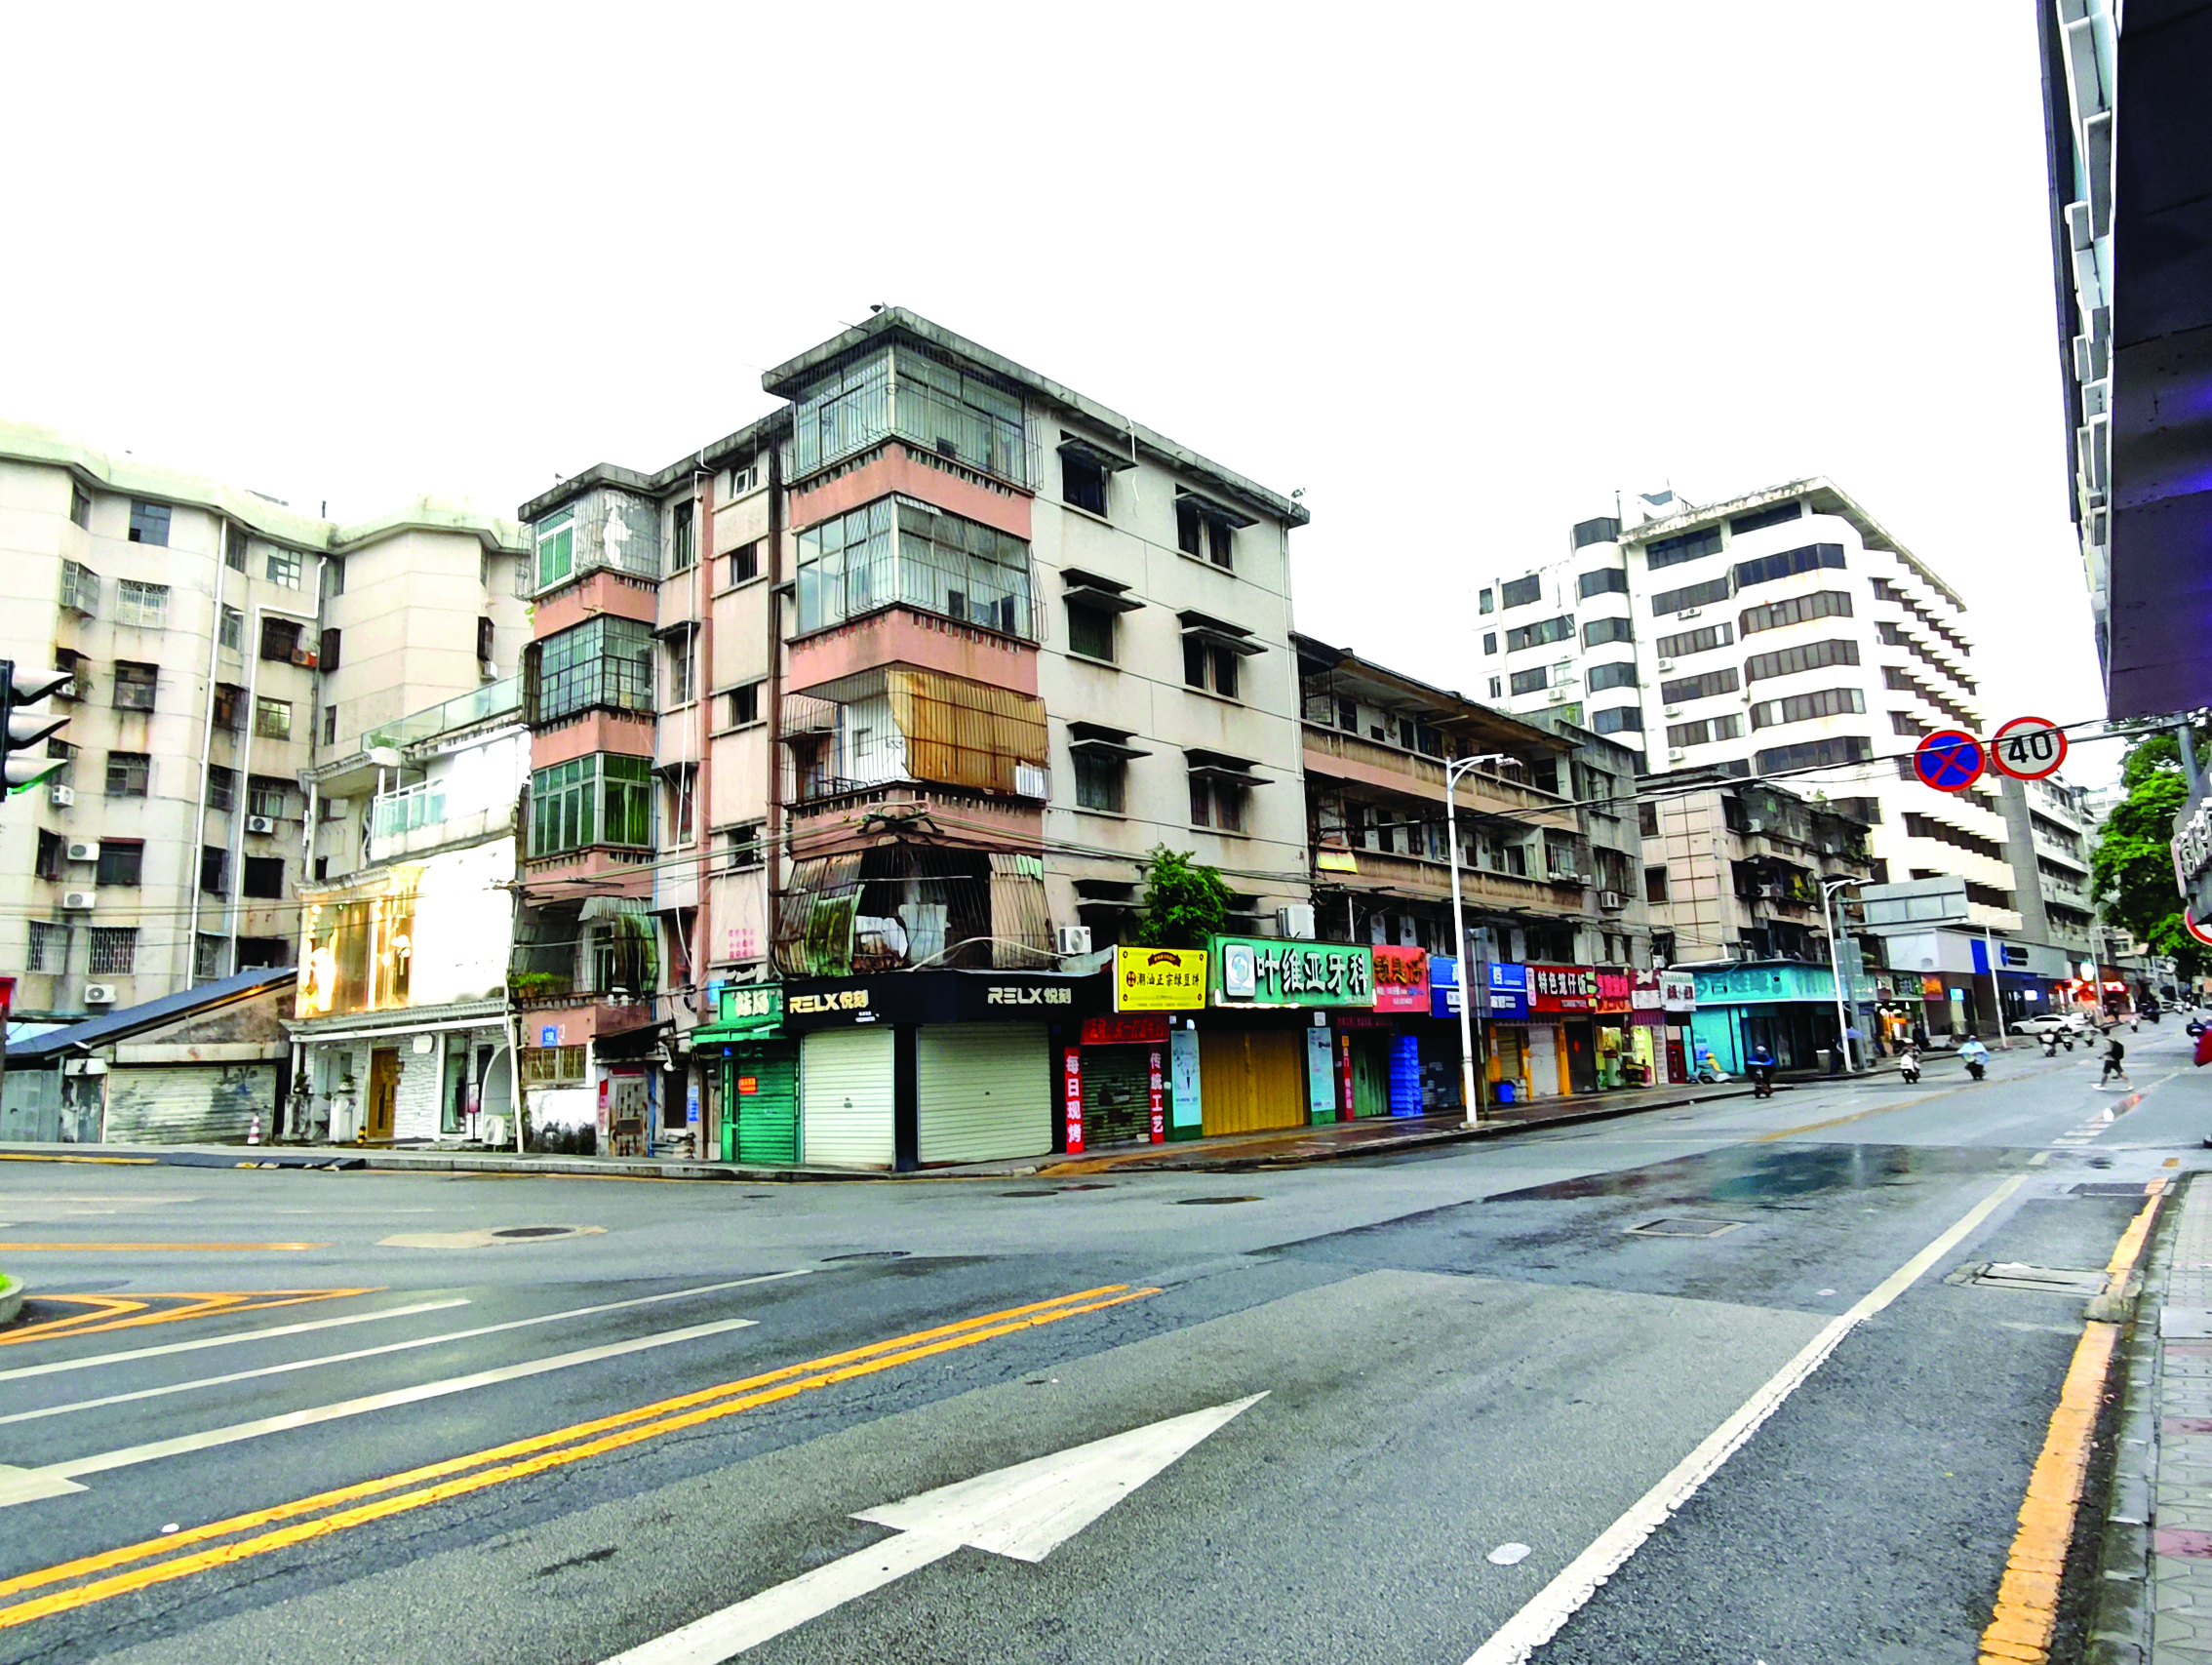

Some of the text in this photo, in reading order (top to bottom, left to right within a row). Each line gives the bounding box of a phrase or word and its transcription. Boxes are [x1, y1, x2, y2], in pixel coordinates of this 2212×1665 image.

[2008, 733, 2053, 763] 40
[1256, 948, 1368, 995] 叶维亚牙科
[1066, 1054, 1082, 1143] 每日现烤
[1150, 1051, 1164, 1133] 传统工艺
